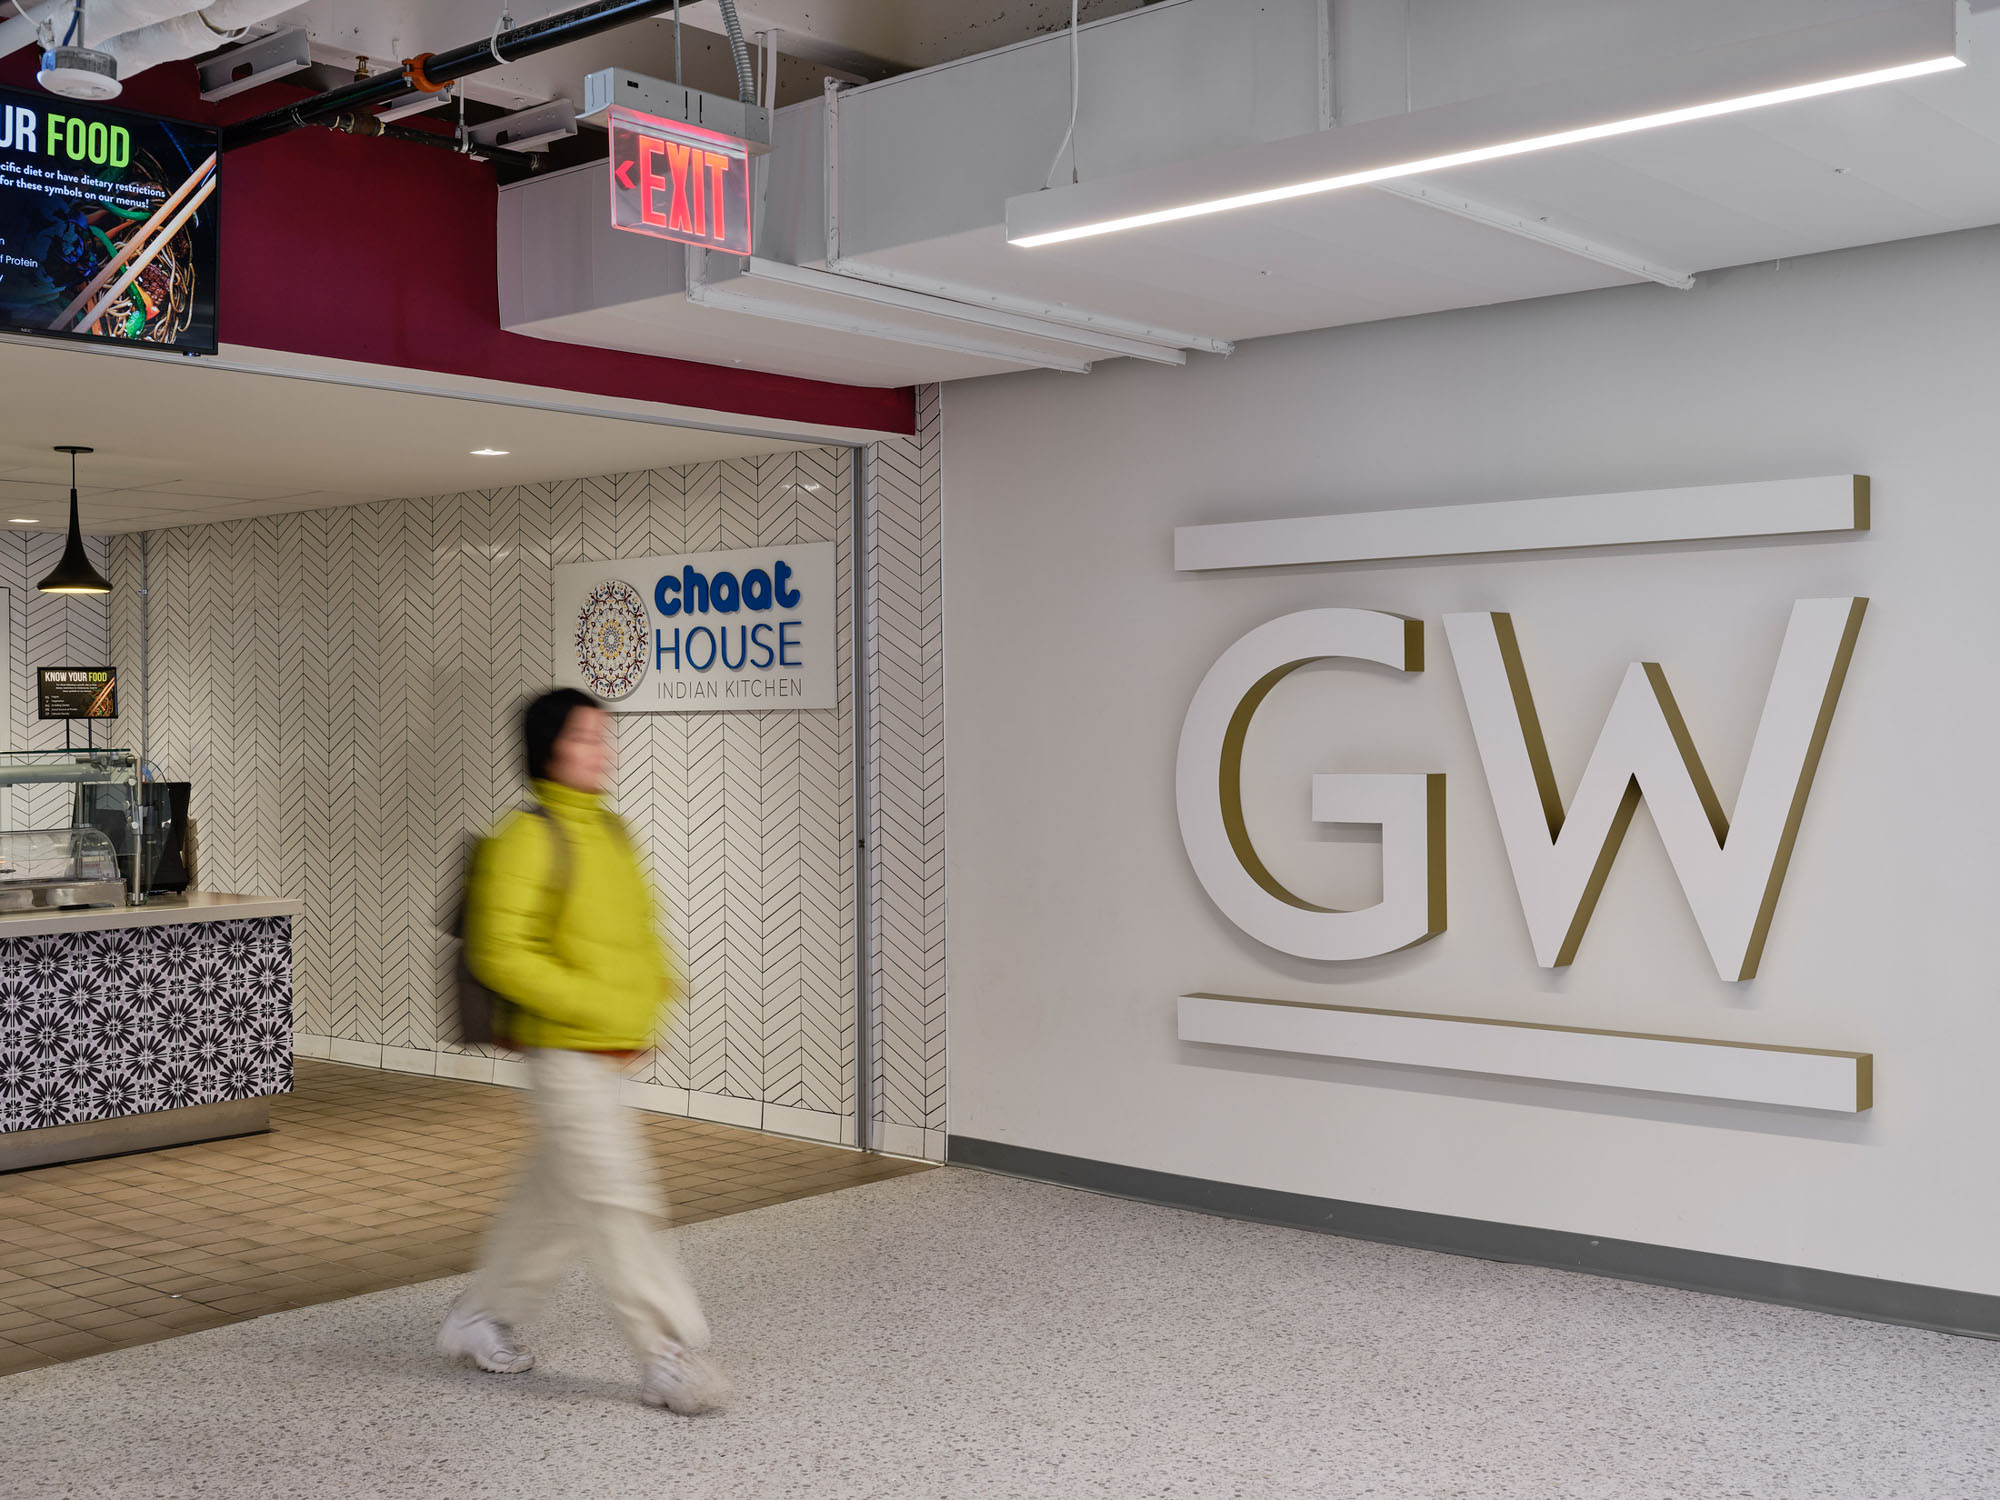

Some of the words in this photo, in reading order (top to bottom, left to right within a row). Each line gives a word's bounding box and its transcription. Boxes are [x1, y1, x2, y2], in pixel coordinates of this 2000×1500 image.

[478, 36, 506, 53] ASM
[0, 105, 37, 153] UR
[47, 113, 130, 168] FOOD
[0, 175, 15, 186] for
[16, 178, 43, 191] these
[44, 185, 82, 198] symbols
[98, 195, 115, 203] our
[116, 197, 149, 209] menus!
[23, 165, 43, 177] diet
[57, 170, 79, 183] have
[81, 175, 113, 192] dietary
[115, 183, 166, 198] restrictions
[638, 134, 729, 240] EXIT
[5, 255, 38, 268] Protein
[654, 560, 801, 616] chaat
[656, 621, 802, 671] HOUSE
[45, 672, 67, 682] KNOW
[68, 672, 88, 682] YOUR
[88, 672, 108, 682] FOOD
[657, 680, 718, 700] INDIAN
[725, 678, 803, 698] KITCHEN
[1175, 596, 1870, 982] GW
